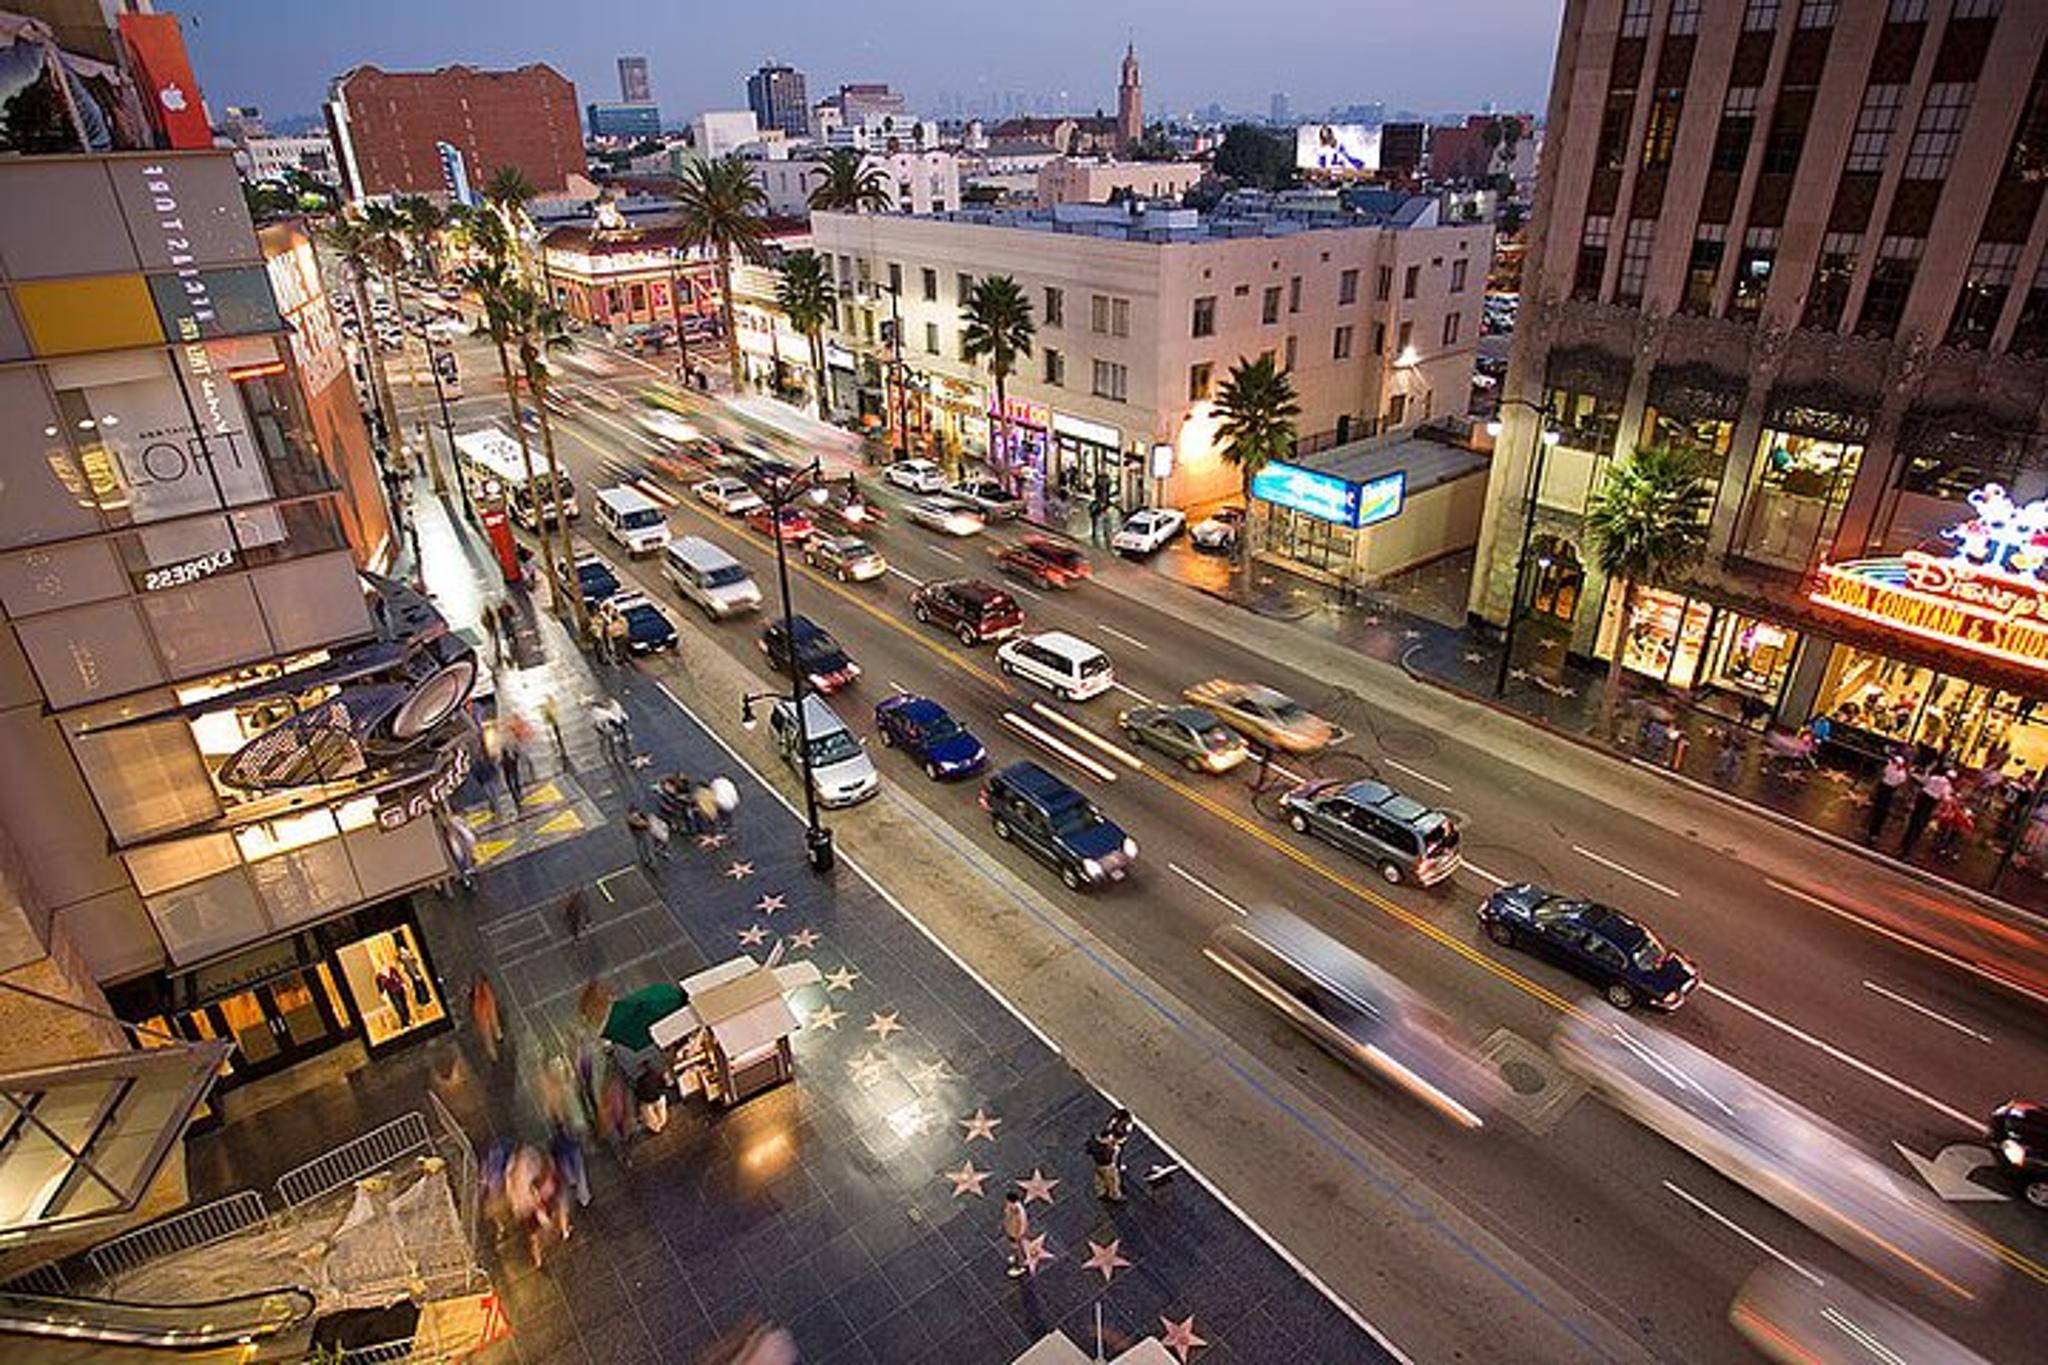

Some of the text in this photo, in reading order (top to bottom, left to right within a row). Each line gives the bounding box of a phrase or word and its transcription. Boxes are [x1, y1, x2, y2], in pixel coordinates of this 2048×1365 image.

[114, 429, 243, 488] LOFT
[1828, 573, 1870, 609] SODA
[1872, 588, 1966, 636] FOUNTAIN
[1967, 619, 1984, 642] &
